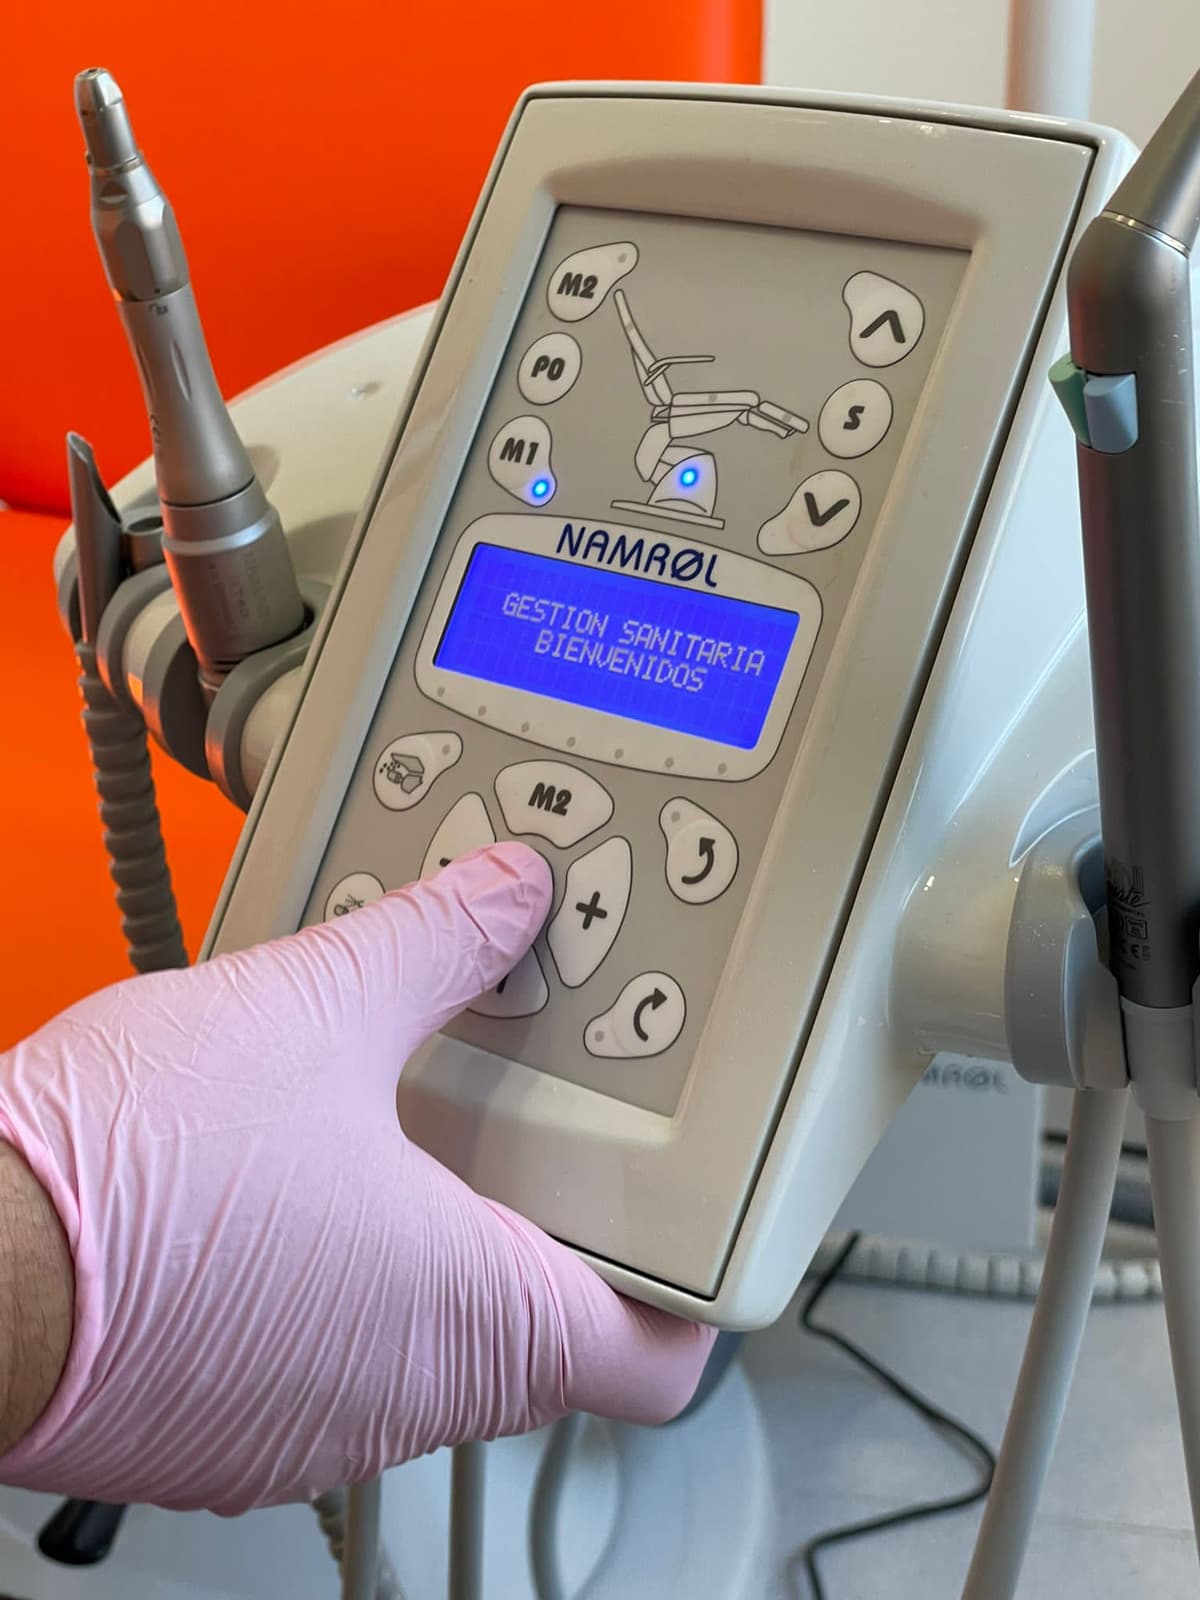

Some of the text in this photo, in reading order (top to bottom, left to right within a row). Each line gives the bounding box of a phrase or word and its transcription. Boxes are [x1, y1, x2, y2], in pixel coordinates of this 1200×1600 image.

[557, 272, 598, 298] M2
[843, 405, 865, 430] S
[500, 437, 539, 466] M1
[502, 592, 765, 676] GESTION SANITARIA
[534, 629, 708, 692] BIENVENIDOS
[528, 782, 572, 816] M2
